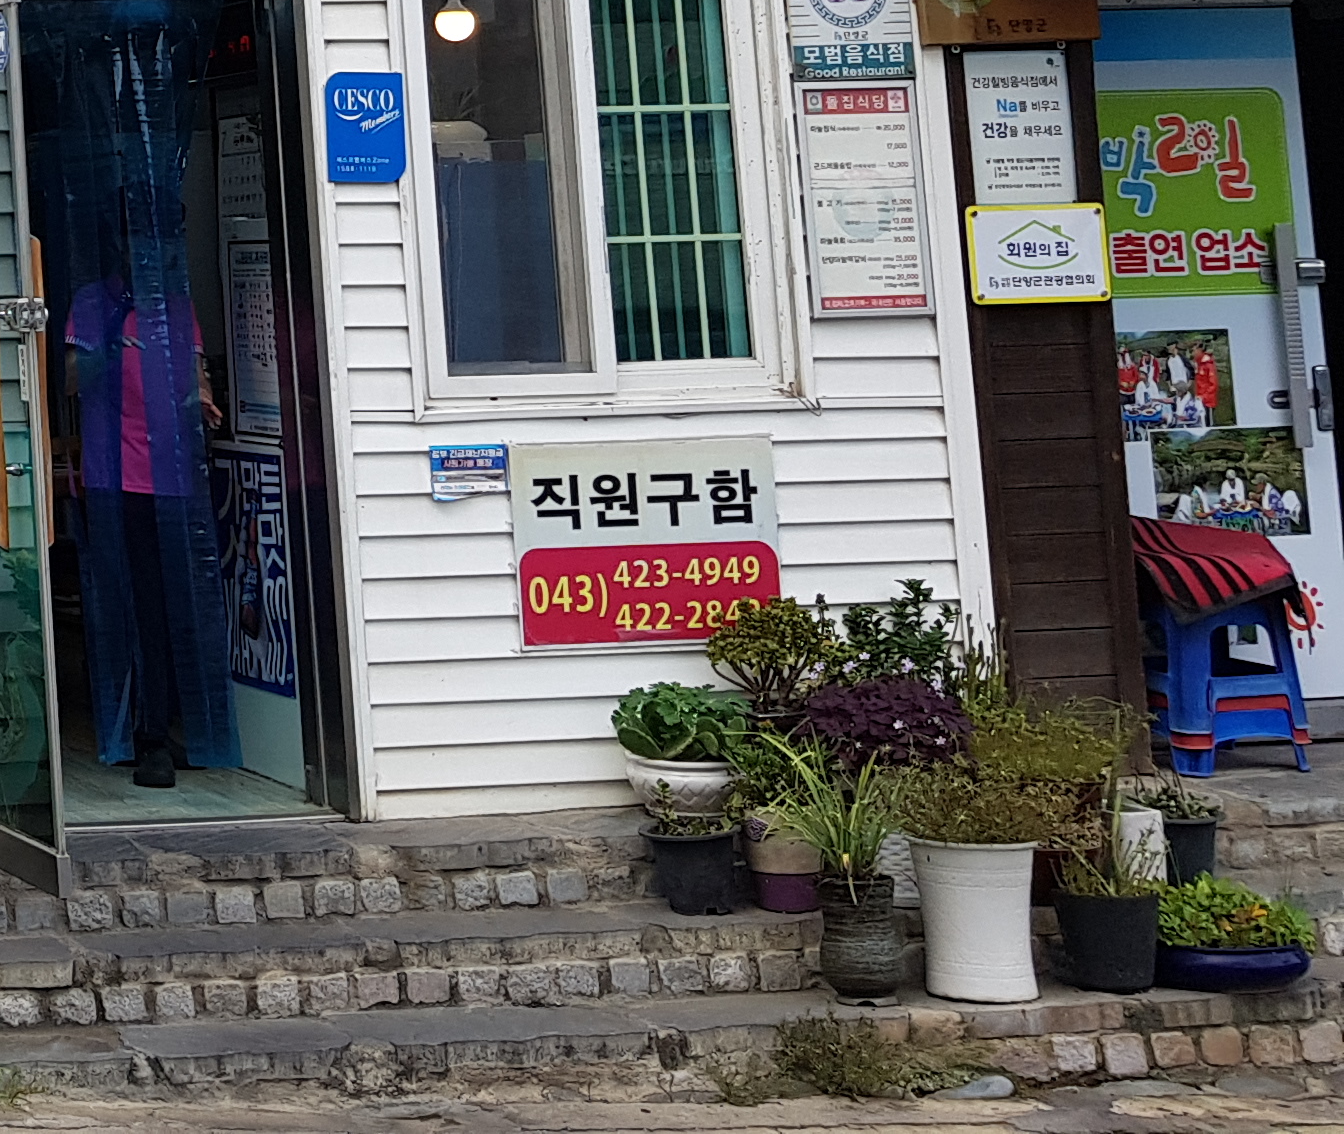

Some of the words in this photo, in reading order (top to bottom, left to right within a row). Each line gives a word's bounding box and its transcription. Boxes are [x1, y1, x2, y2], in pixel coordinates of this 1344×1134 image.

[802, 42, 905, 65] 모범음식점
[804, 66, 840, 79] Good
[842, 64, 906, 77] Restaurant
[333, 88, 394, 111] CESCO
[825, 94, 885, 110] 돌집식당
[1006, 241, 1052, 258] 회원의
[1054, 240, 1070, 257] 집
[1111, 231, 1188, 275] 출연
[1193, 230, 1266, 274] 업소
[530, 468, 758, 531] 직원구함
[528, 571, 608, 618] 043)
[613, 555, 760, 589] 423-4949
